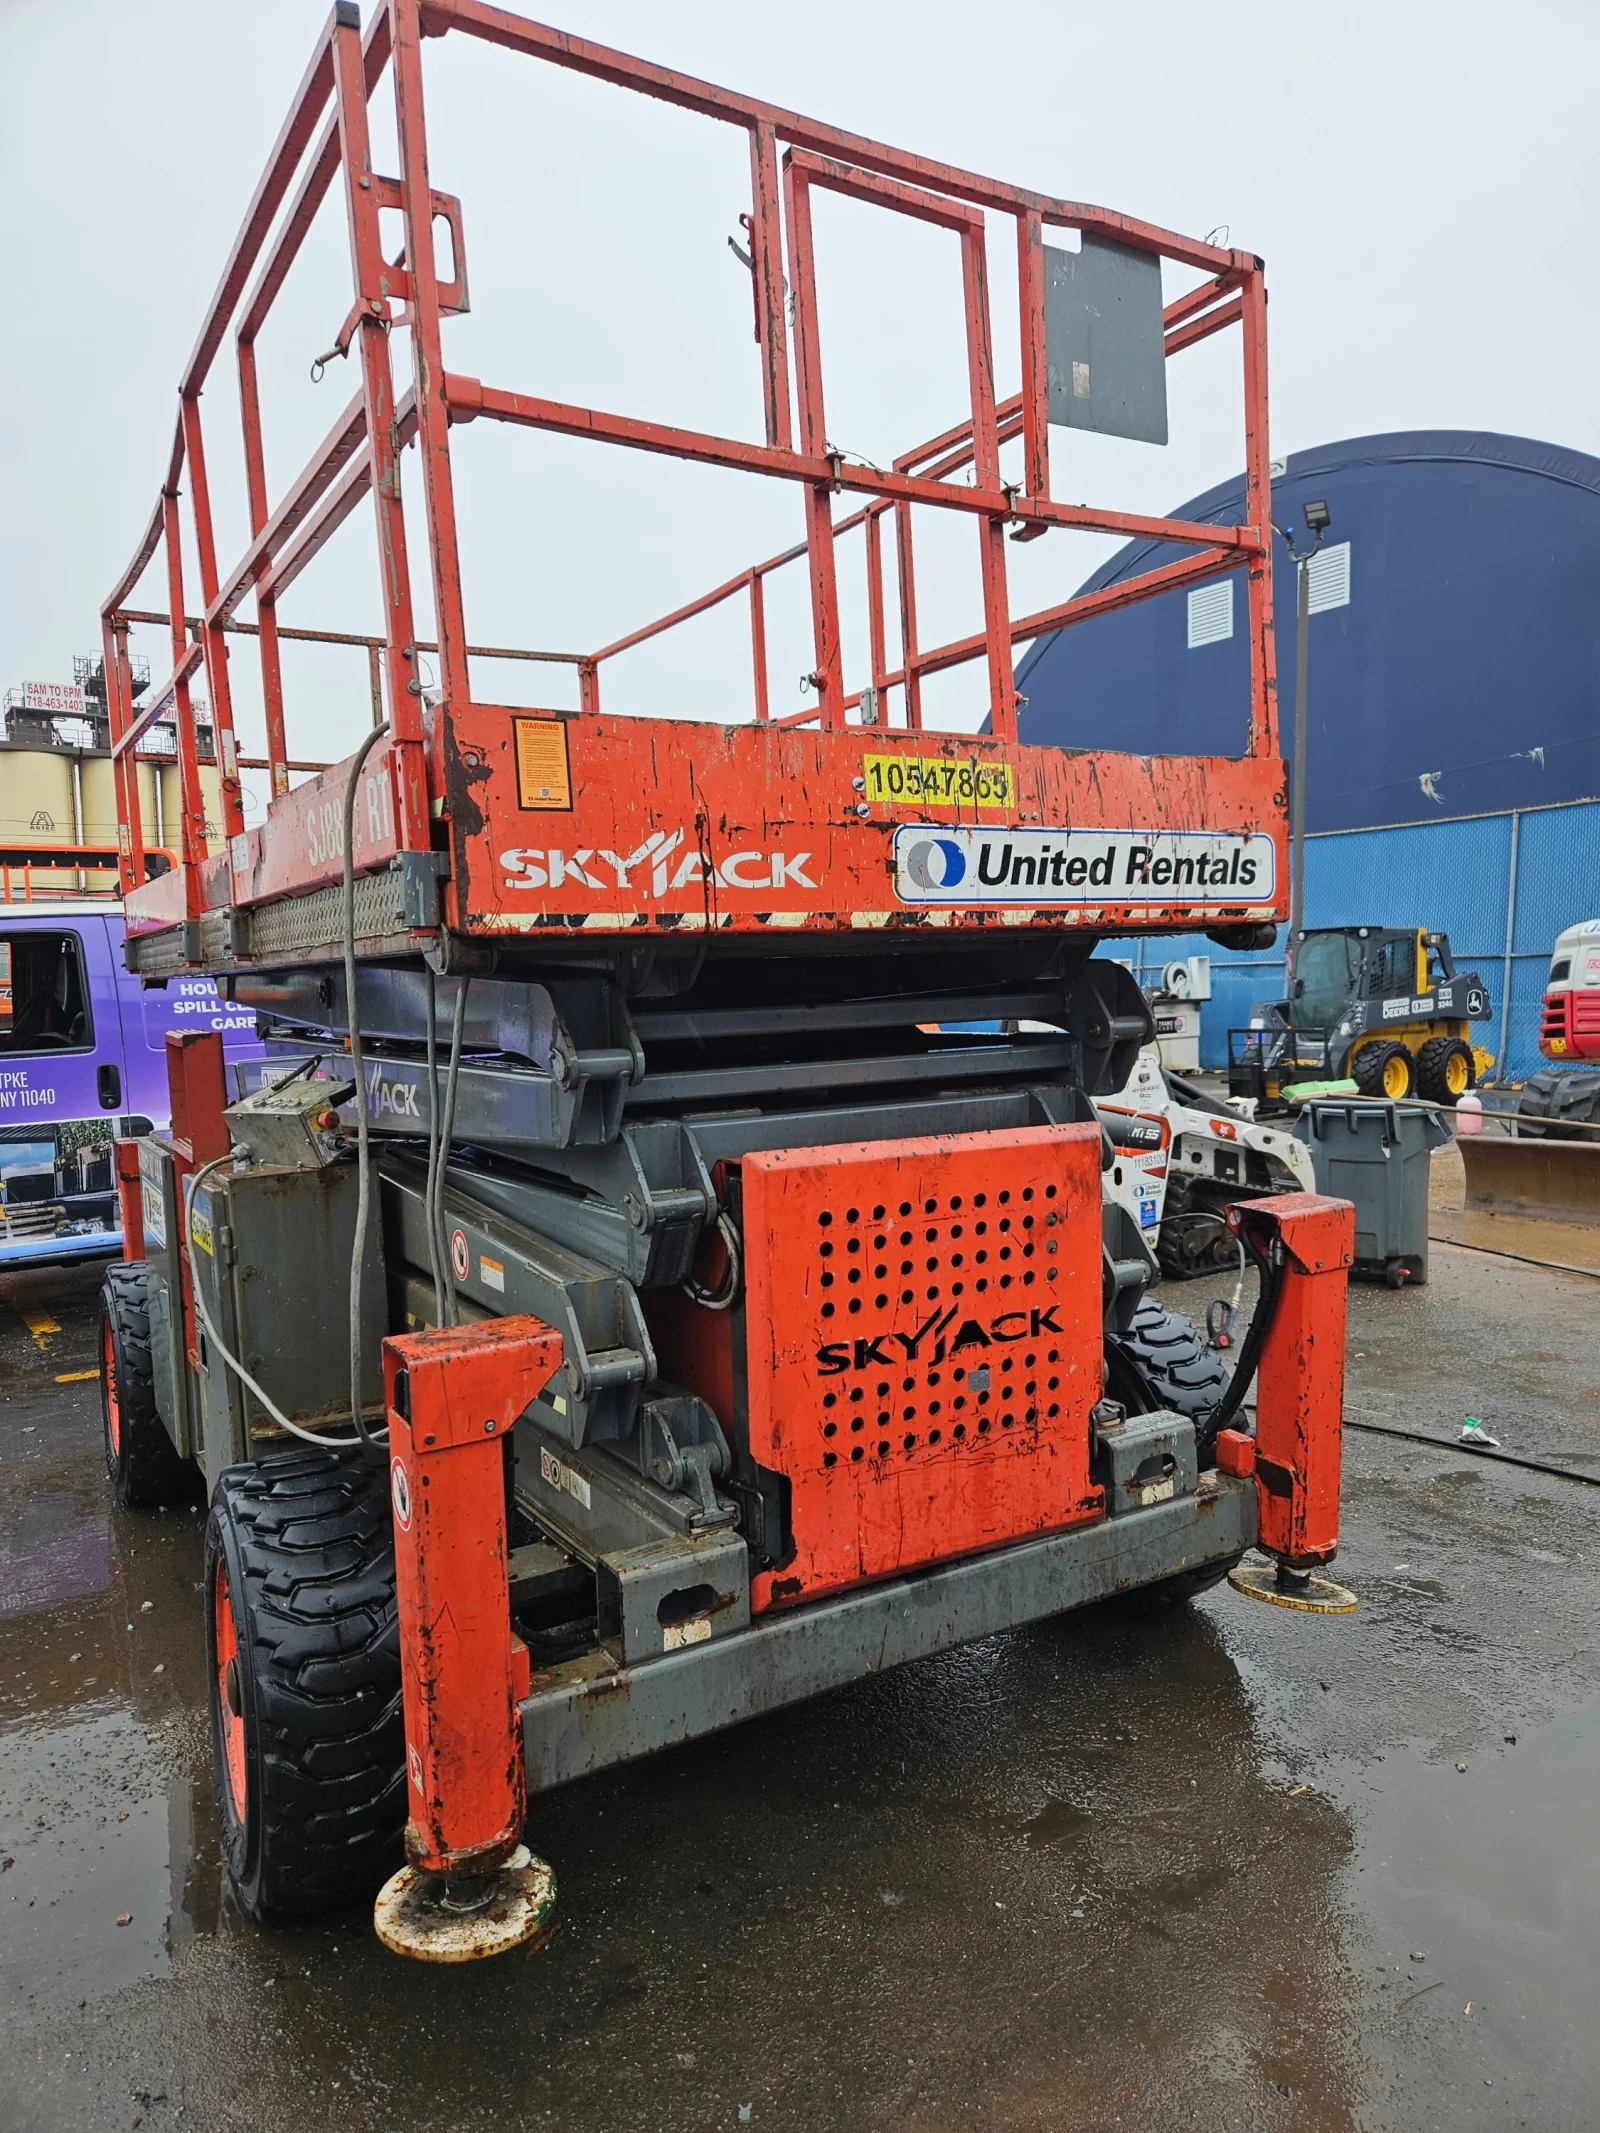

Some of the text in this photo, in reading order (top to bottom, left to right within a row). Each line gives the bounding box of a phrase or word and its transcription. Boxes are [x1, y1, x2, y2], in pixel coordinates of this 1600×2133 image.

[27, 683, 82, 699] 6AM TO 6PM
[26, 695, 84, 712] 718-463-1403
[521, 721, 559, 731] WARNING
[868, 761, 1009, 800] 10547865
[365, 768, 390, 844] RT
[498, 826, 818, 899] SKYJACK
[977, 843, 1258, 886] United Rentals
[173, 1000, 222, 1014] SPILL
[1382, 1005, 1410, 1019] DEERE
[0, 1088, 56, 1108] NY 11040
[1133, 1153, 1166, 1169] 11183100
[1145, 1189, 1162, 1197] Rentals
[815, 1302, 1065, 1376] SKYJACK
